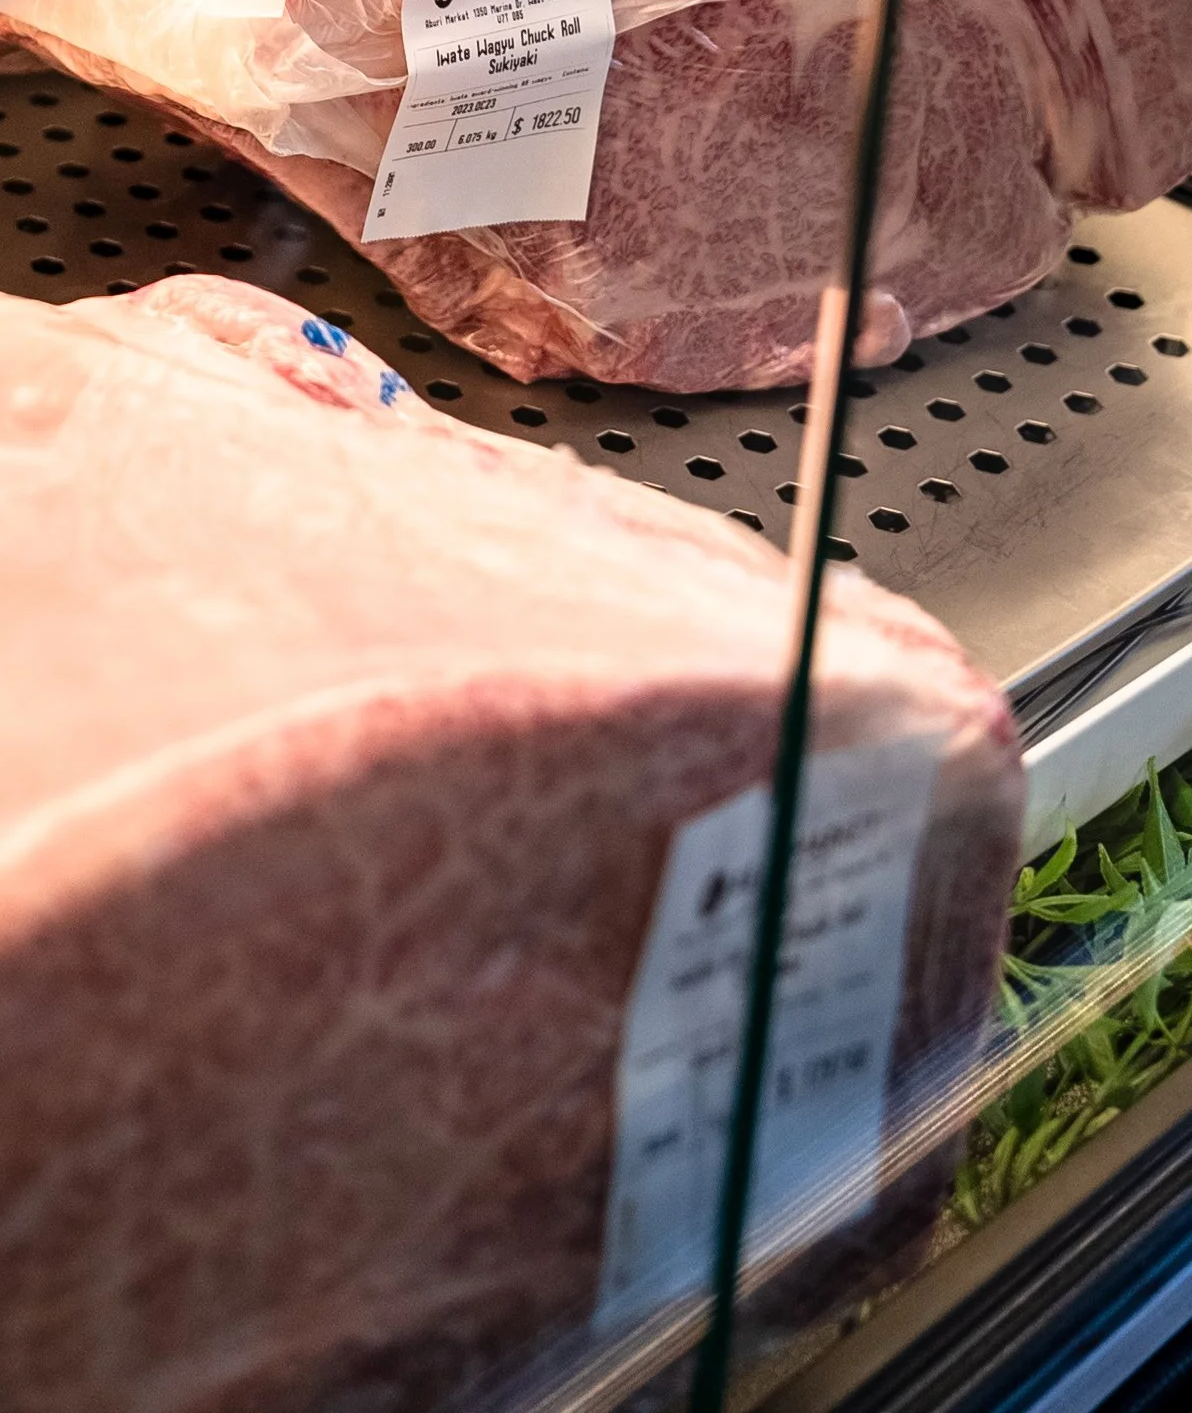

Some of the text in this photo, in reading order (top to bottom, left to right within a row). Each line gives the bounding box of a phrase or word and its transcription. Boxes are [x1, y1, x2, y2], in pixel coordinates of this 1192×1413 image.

[424, 16, 443, 29] Aburi
[445, 11, 469, 25] Market
[473, 6, 488, 18] 1350
[490, 2, 512, 14] Marine
[436, 16, 581, 67] Iwate Wagyu Chuck Roll
[488, 49, 538, 75] Sukiyaki
[406, 106, 581, 153] 300.00 6.075 kg $ 1822.50
